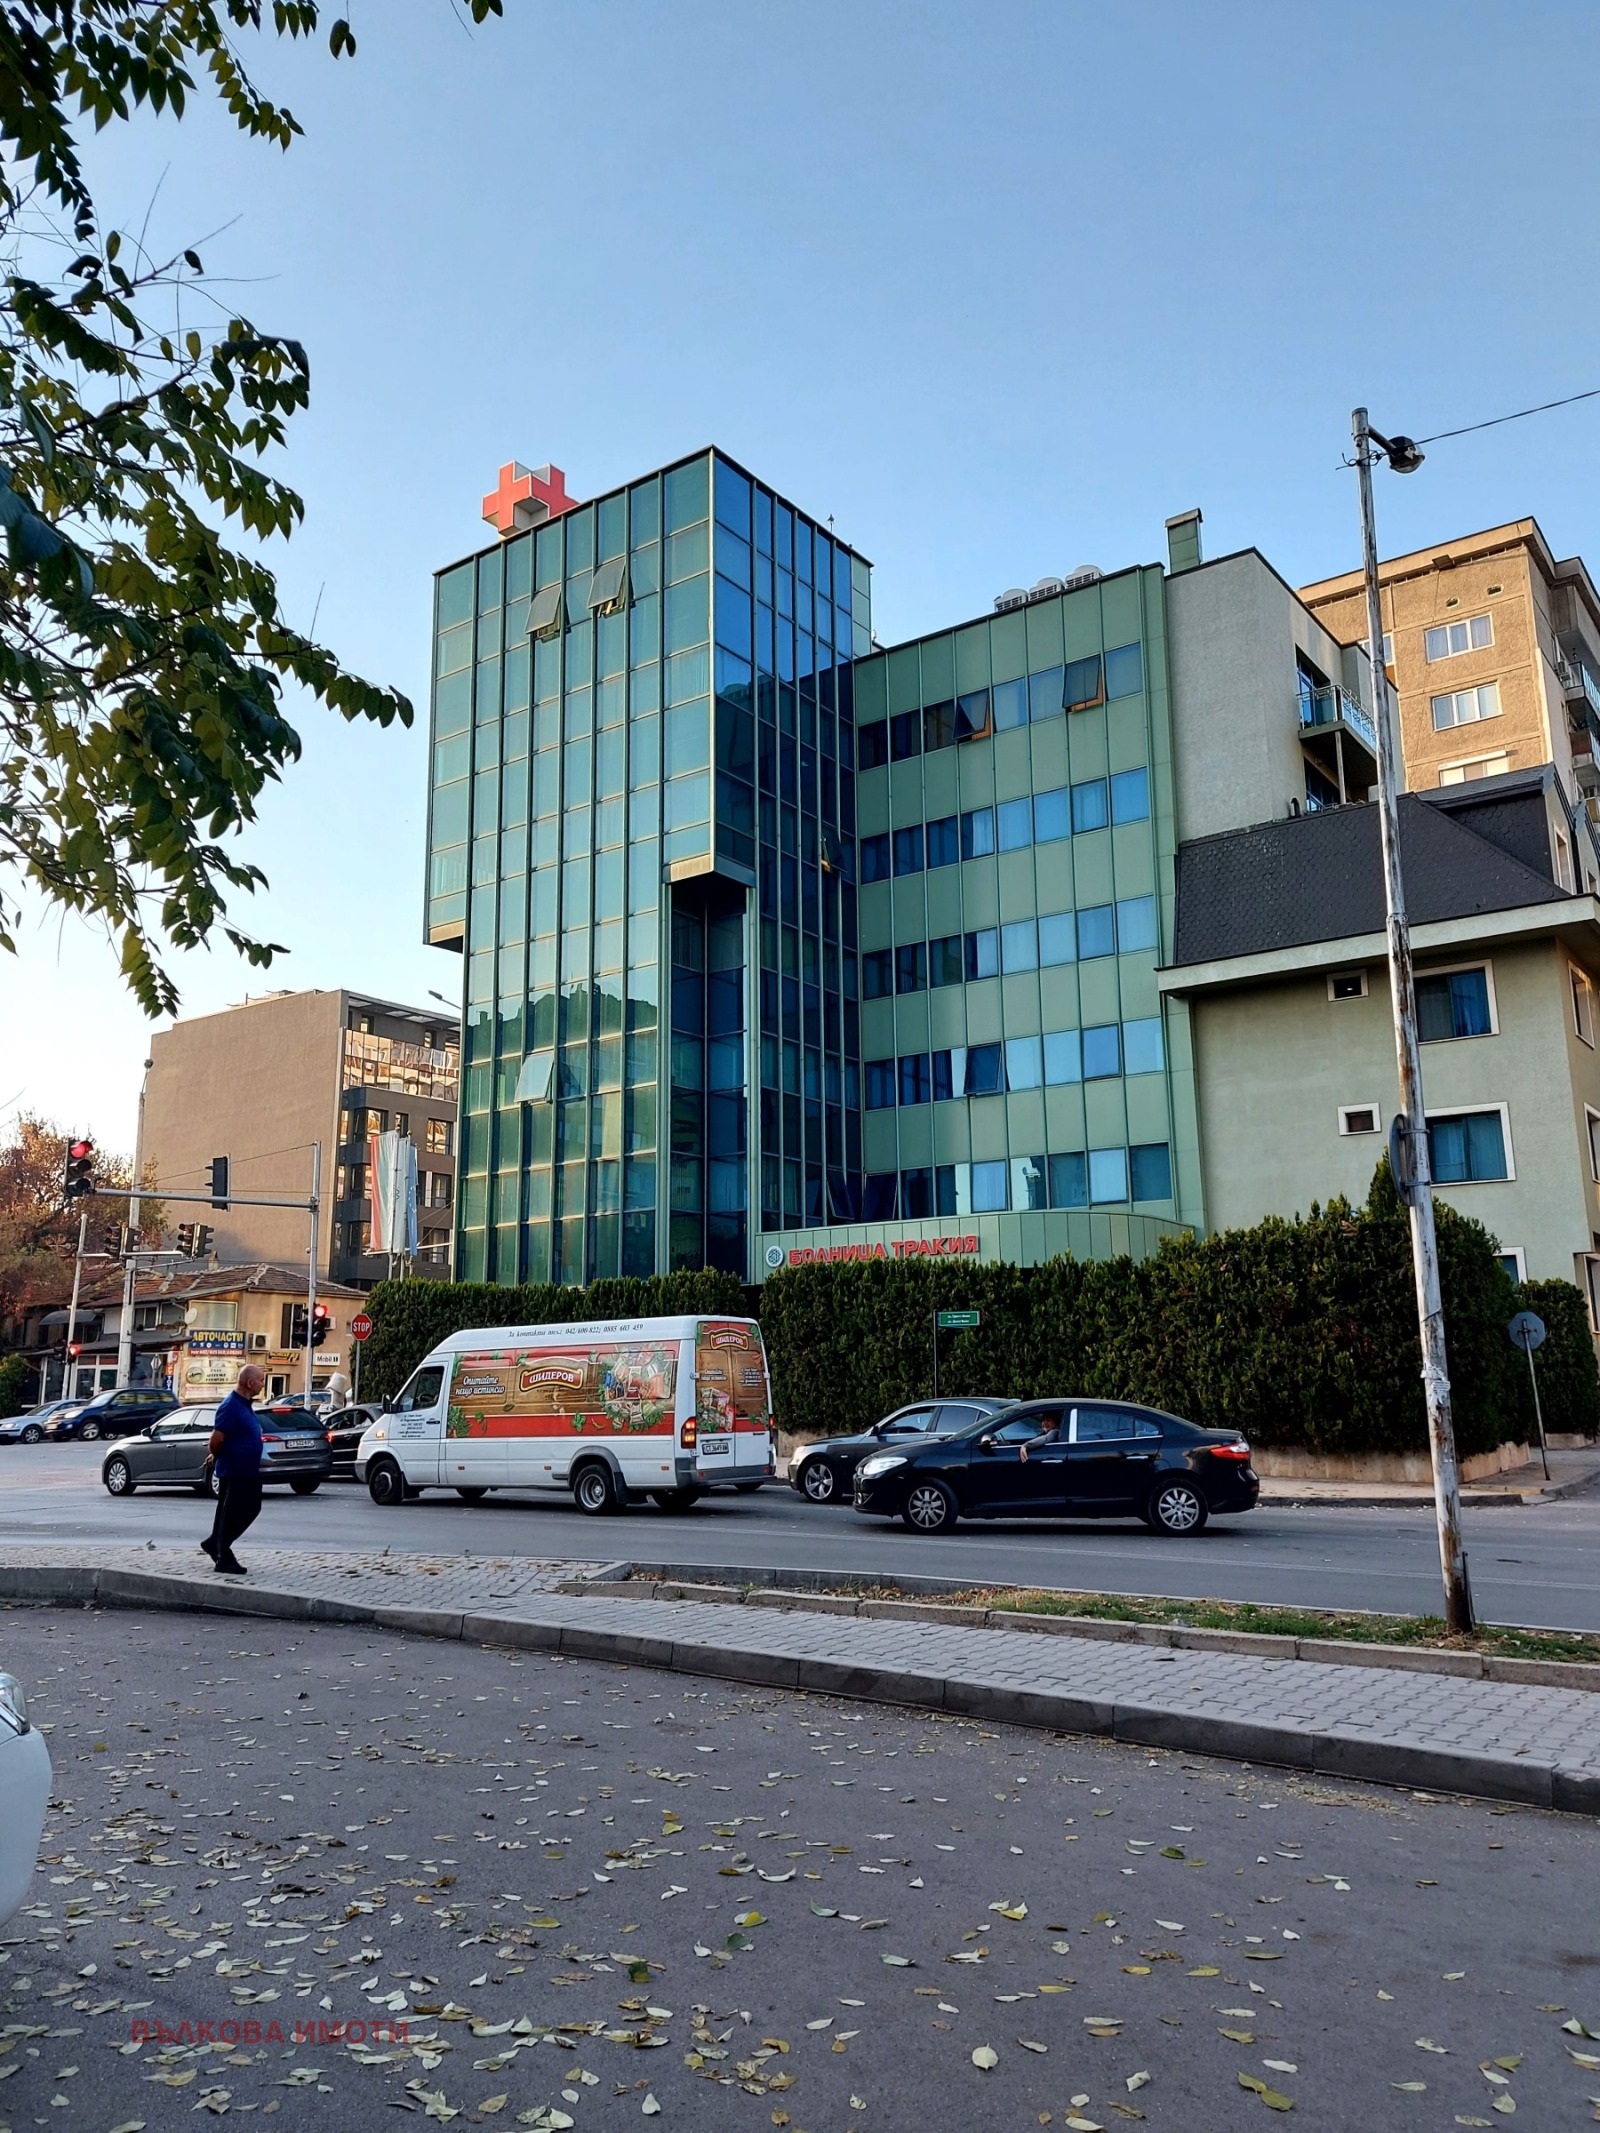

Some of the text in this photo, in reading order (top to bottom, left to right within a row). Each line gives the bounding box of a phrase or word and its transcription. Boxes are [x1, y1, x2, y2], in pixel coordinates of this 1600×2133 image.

[788, 1235, 979, 1266] БОЛНИЦА ТРАКИЯ
[353, 1322, 370, 1332] STOP
[193, 1331, 244, 1342] АВТОЧАСТИ
